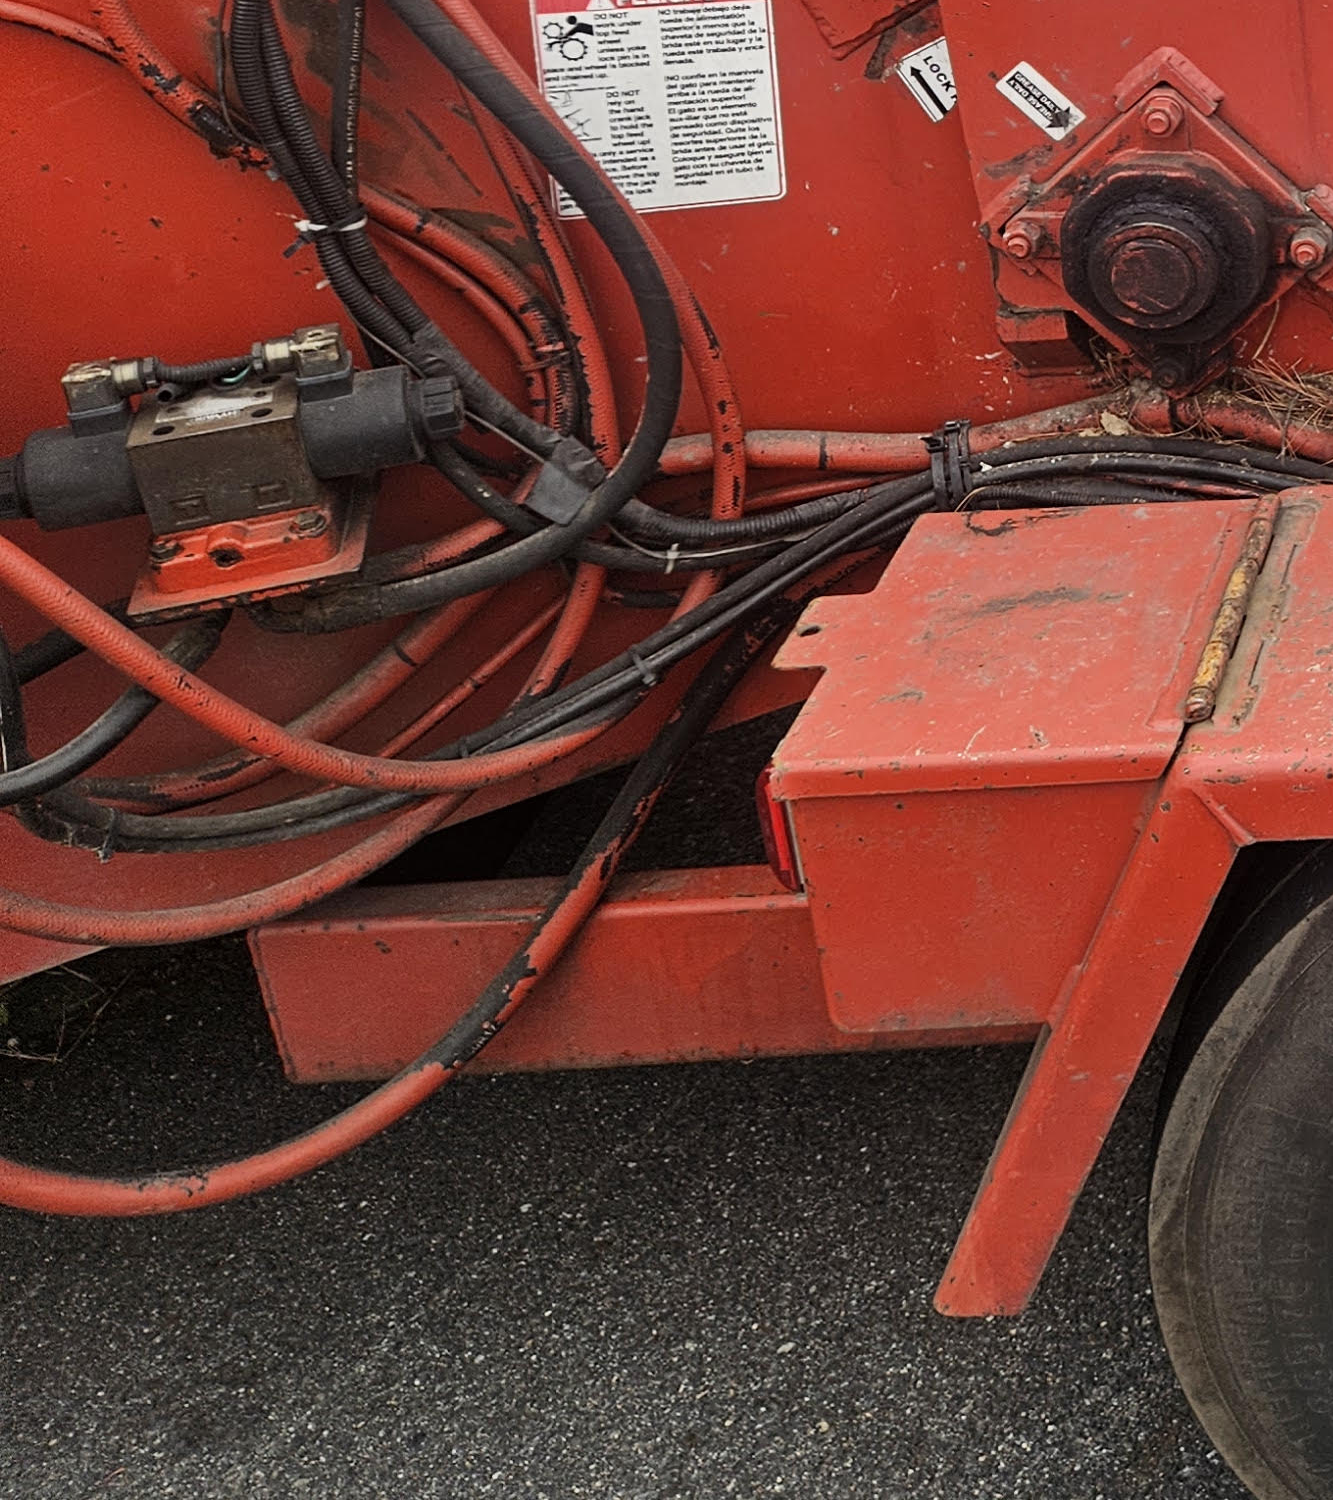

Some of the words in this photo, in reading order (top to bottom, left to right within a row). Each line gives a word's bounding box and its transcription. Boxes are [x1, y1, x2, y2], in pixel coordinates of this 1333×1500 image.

[923, 56, 956, 92] LOCK
[1009, 79, 1029, 97] DAILY
[1014, 73, 1042, 98] GREASE
[1040, 95, 1060, 113] DAILY
